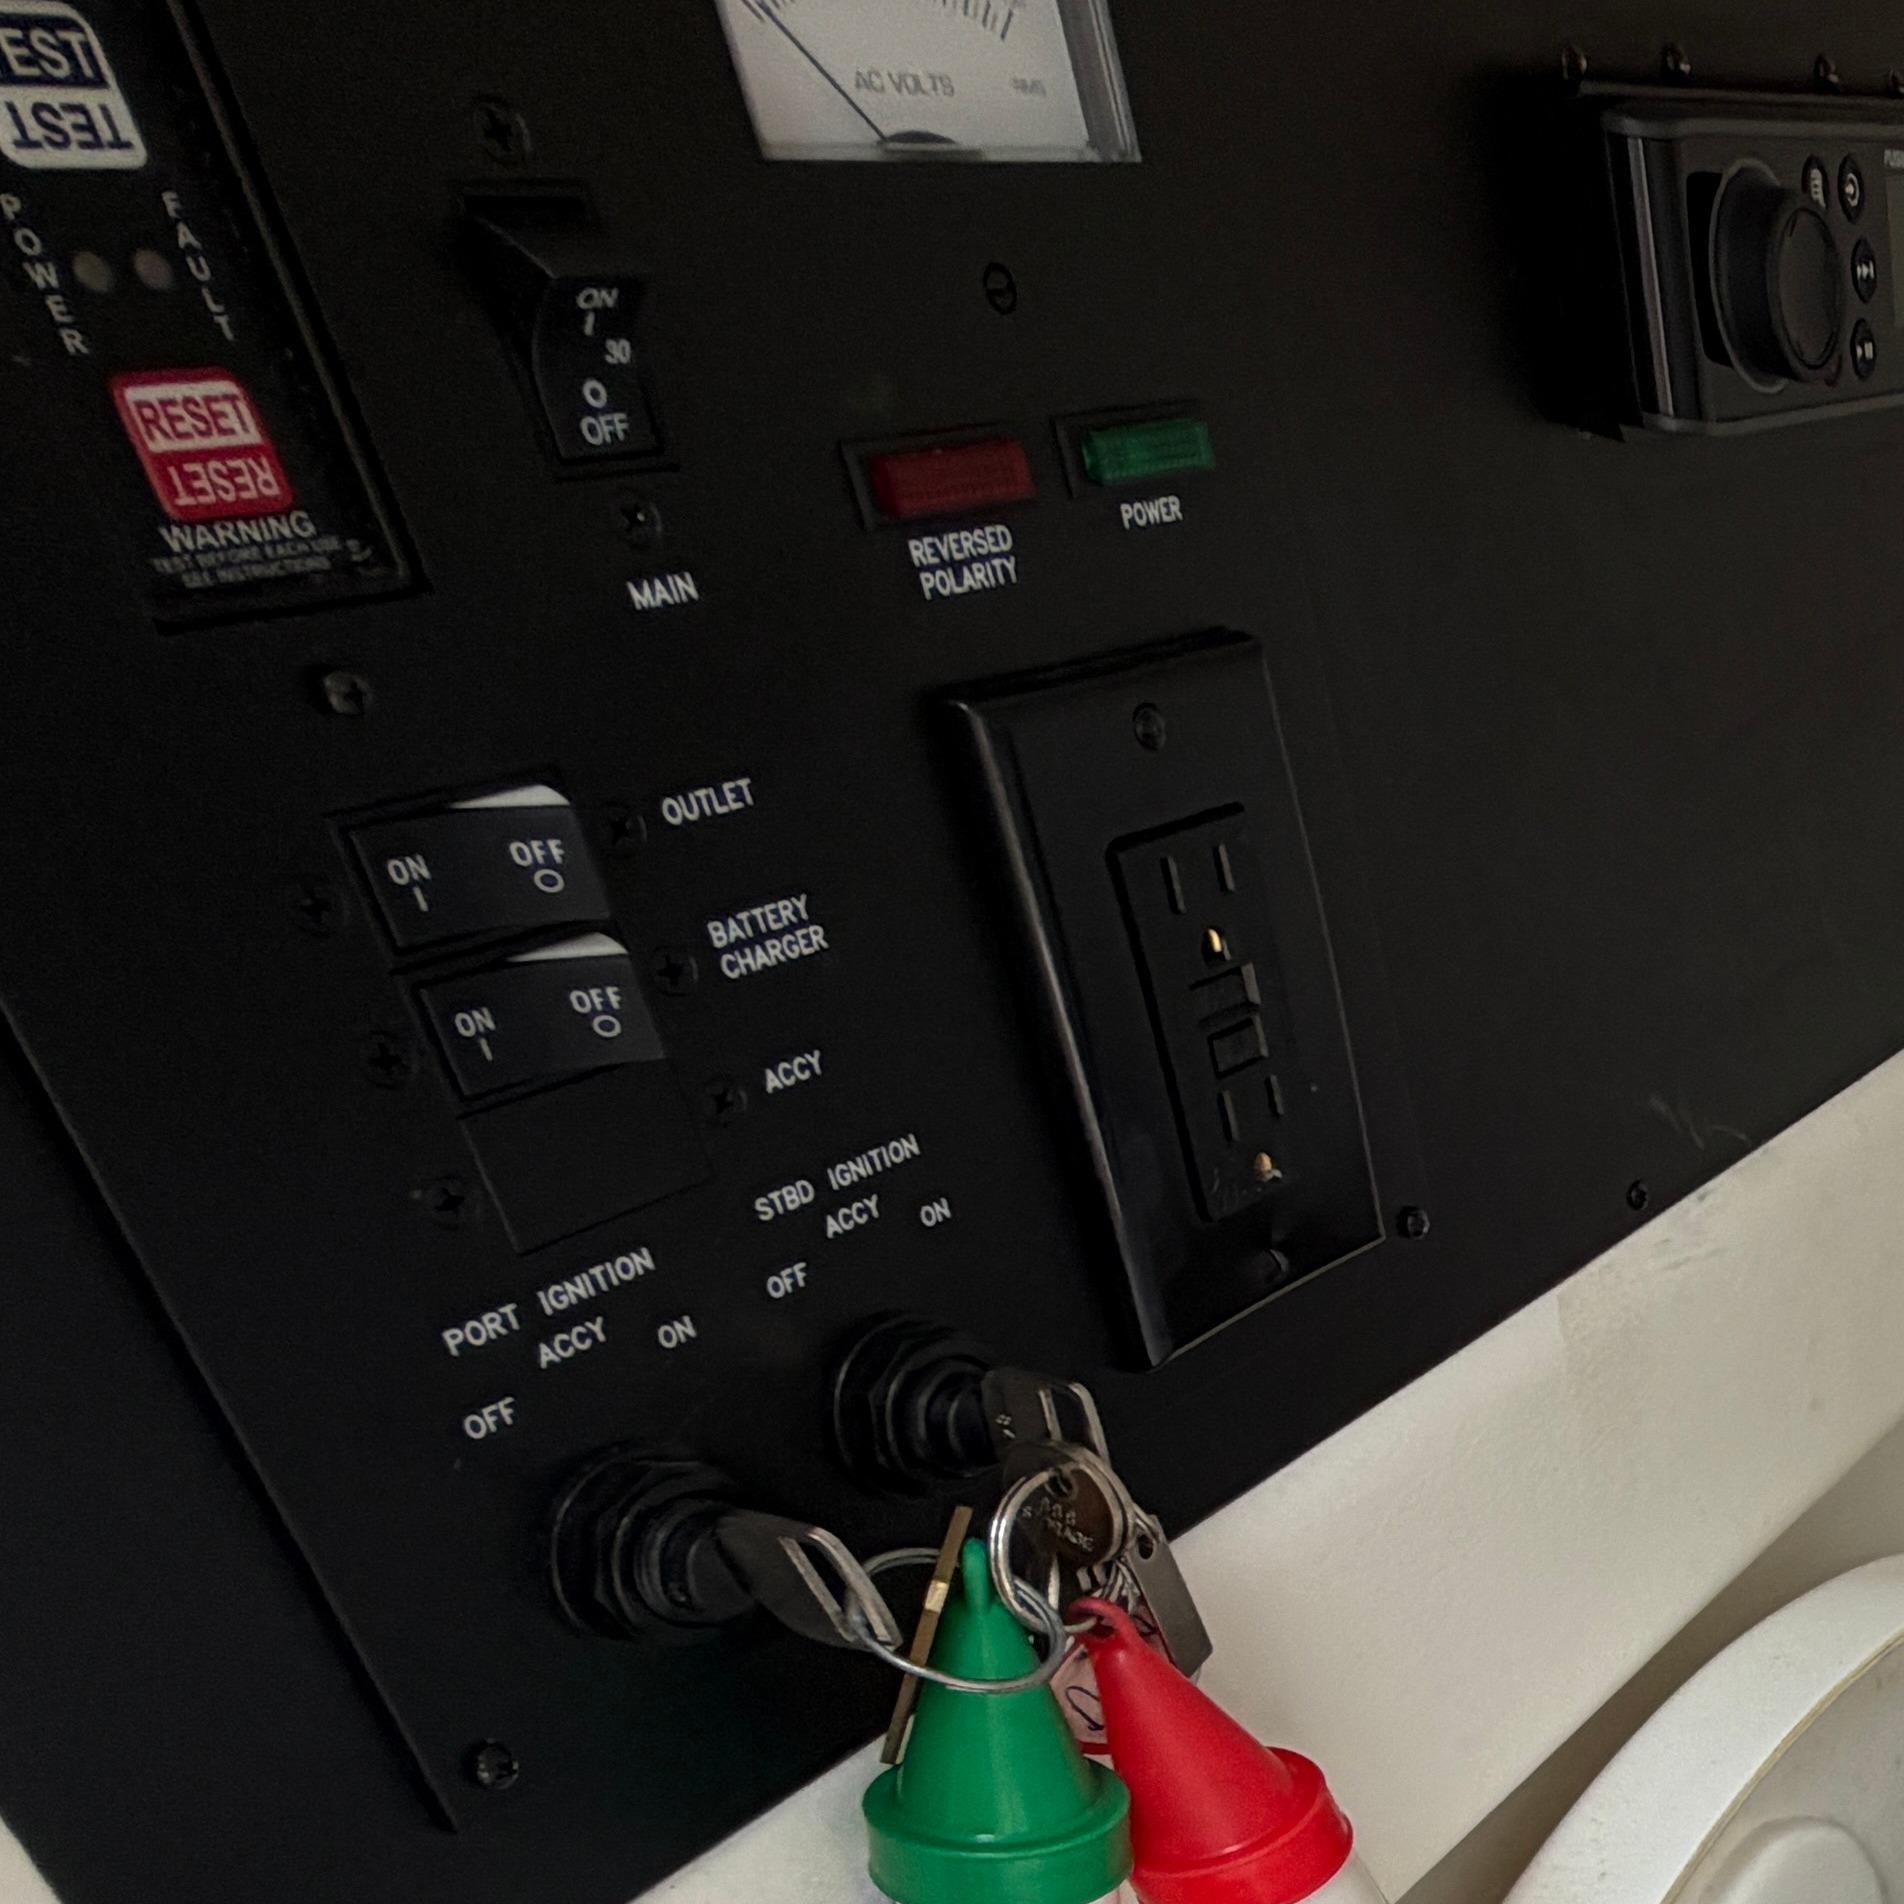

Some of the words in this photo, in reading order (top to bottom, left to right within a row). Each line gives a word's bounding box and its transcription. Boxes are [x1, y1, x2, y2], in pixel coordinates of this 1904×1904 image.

[9, 103, 132, 150] TEST
[1, 193, 88, 354] POWER
[161, 191, 235, 340] FAULT
[576, 287, 618, 310] ON
[131, 394, 255, 440] RESET
[579, 413, 628, 445] OFF
[166, 456, 279, 504] RESET
[158, 510, 317, 552] WARNING
[1119, 495, 1182, 528] POWER
[907, 524, 1013, 566] REVERSED
[626, 571, 699, 609] MAIN
[918, 556, 1018, 599] POLARITY
[661, 778, 753, 826] OUTLET
[386, 853, 431, 885] ON
[508, 838, 565, 866] OFF
[706, 893, 811, 948] BATTERY
[720, 925, 829, 980] CHARGER
[453, 1006, 496, 1038] ON
[568, 985, 622, 1015] OFF
[763, 1050, 823, 1093] ACCY
[753, 1178, 815, 1221] STBD
[826, 1133, 920, 1191] IGNITION
[765, 1262, 808, 1300] OFF
[823, 1195, 881, 1238] ACCY
[918, 1198, 951, 1228] ON
[441, 1303, 522, 1356] PORT
[537, 1247, 656, 1315] IGNITION
[462, 1397, 516, 1440] OFF
[536, 1317, 608, 1368] ACCY
[656, 1315, 697, 1349] ON
